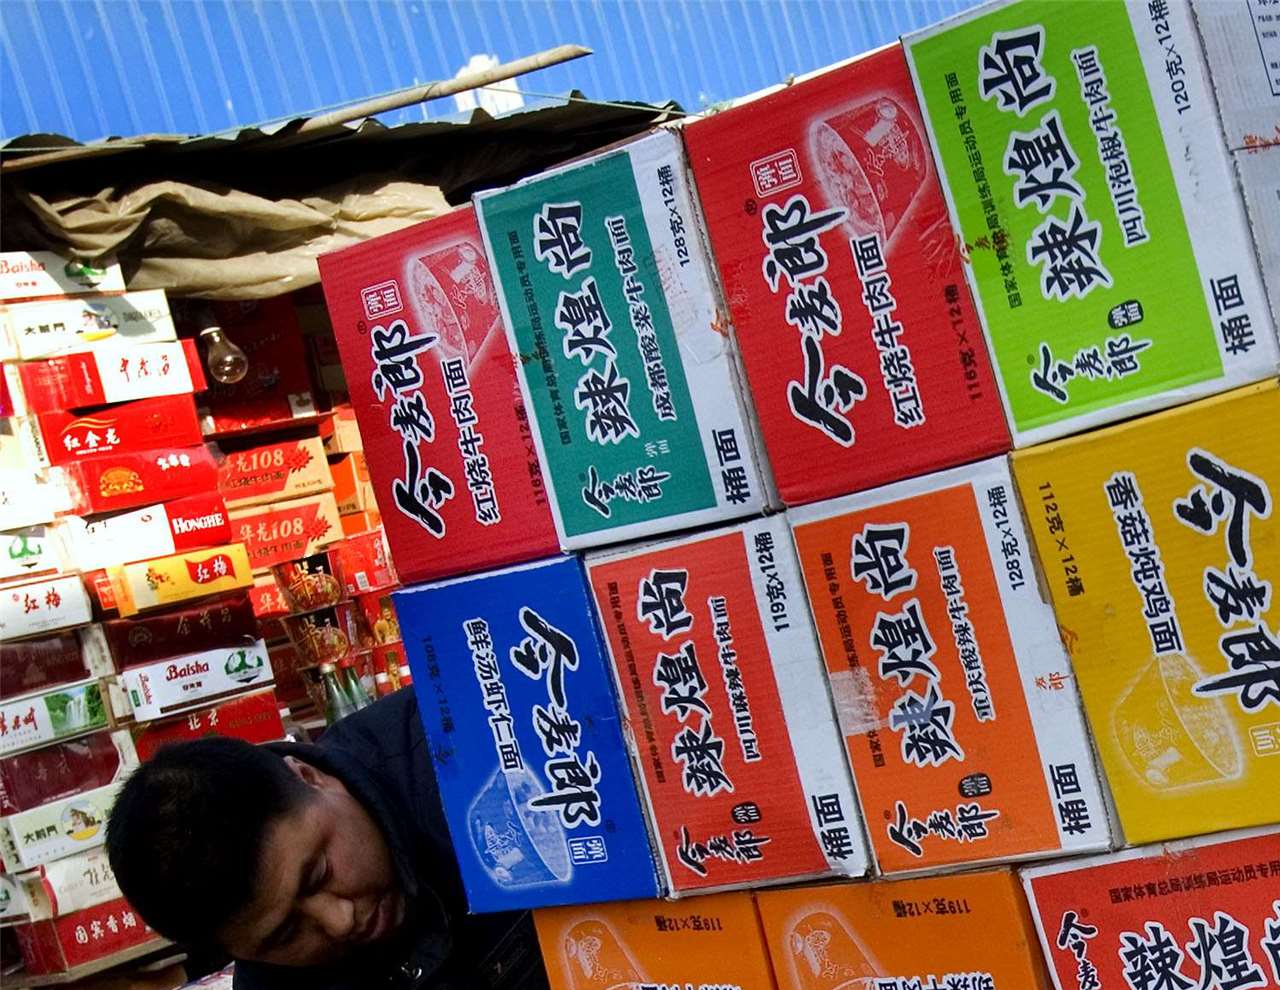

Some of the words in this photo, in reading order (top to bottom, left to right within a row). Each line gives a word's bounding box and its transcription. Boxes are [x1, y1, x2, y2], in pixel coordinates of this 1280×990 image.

[749, 149, 802, 198] 弹面
[978, 24, 1114, 300] 辣煌尚
[1070, 46, 1149, 247] 四川泡椒牛肉面
[361, 281, 402, 319] 弹面
[534, 201, 640, 445] 辣煌尚
[606, 215, 677, 422] 成都酸菜牛肉面
[762, 196, 867, 448] 今麦郎
[850, 234, 926, 430] 红烧牛肉面
[1031, 343, 1151, 404] 今麦郎
[1209, 274, 1257, 355] 桶面
[370, 320, 455, 539] 今麦郎
[442, 359, 502, 524] 红烧牛肉面
[582, 464, 671, 519] 今麦郎
[713, 428, 750, 505] 桶面
[853, 521, 967, 769] 辣煌尚
[934, 545, 997, 722] 重庆酸辣牛肉面
[1103, 471, 1184, 654] 香菇炖鸡面
[166, 661, 210, 682] Baisha
[463, 617, 525, 770] 鲜汤虾仁面
[509, 605, 603, 827] 今麦郎
[637, 568, 735, 795] 辣煌尚
[707, 597, 761, 762] 四川麻辣牛肉面
[678, 826, 771, 877] 今麦郎
[811, 792, 855, 861] 桶面
[885, 801, 1000, 857] 今麦郎
[1050, 762, 1092, 837] 桶面
